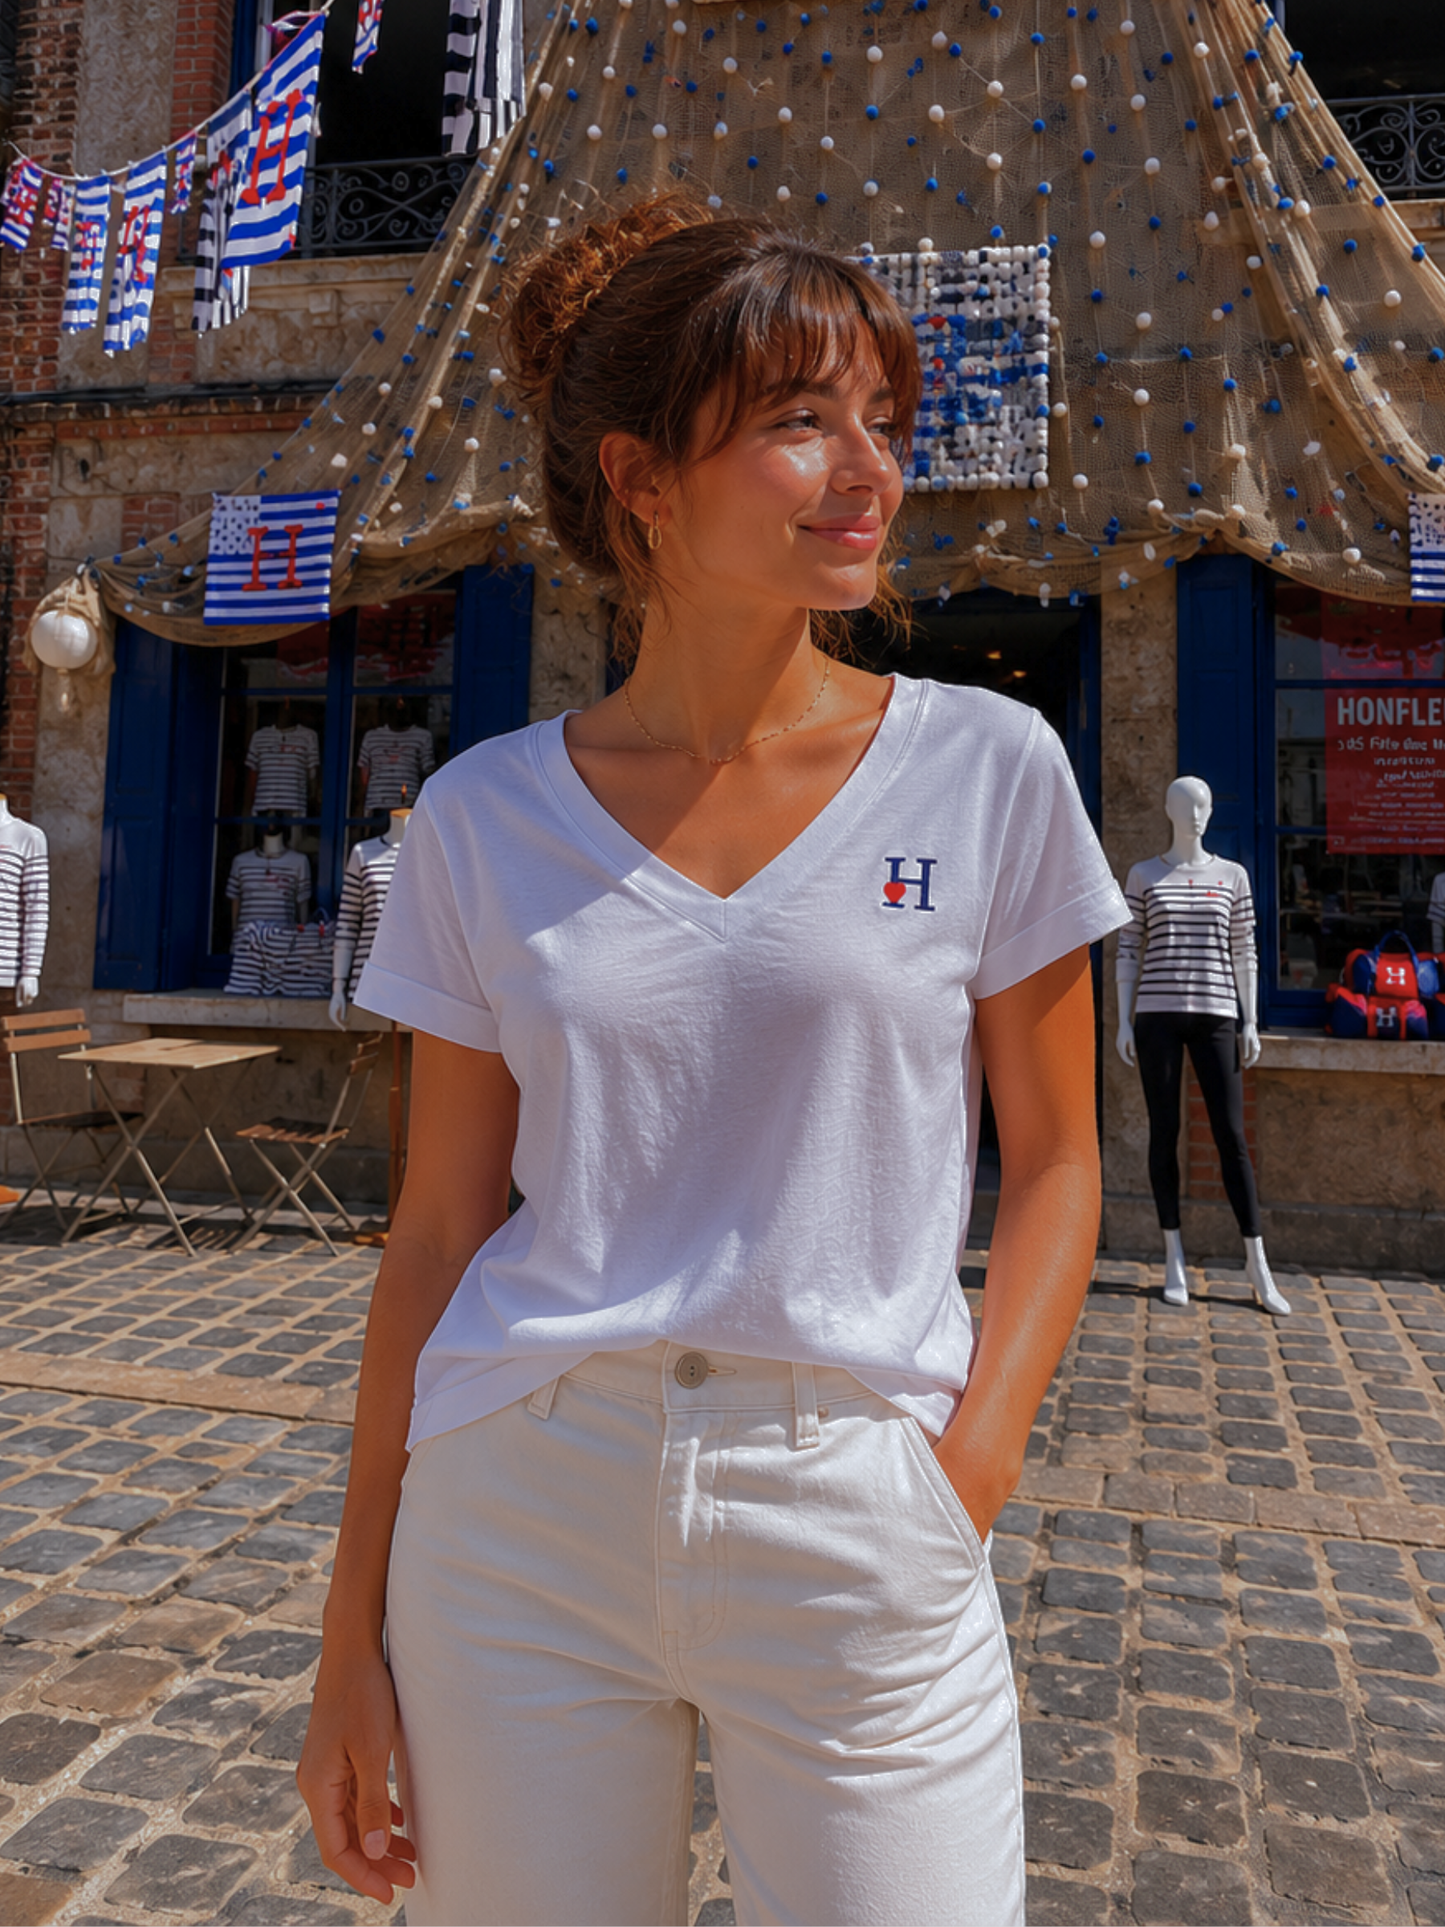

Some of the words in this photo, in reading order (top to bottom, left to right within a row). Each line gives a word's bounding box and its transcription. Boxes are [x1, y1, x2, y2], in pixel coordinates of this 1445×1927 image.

[240, 88, 304, 205] H
[242, 524, 304, 592] H
[1337, 696, 1445, 727] HONFLE
[881, 856, 938, 912] H
[1386, 966, 1406, 986] H
[1376, 1006, 1396, 1027] H
